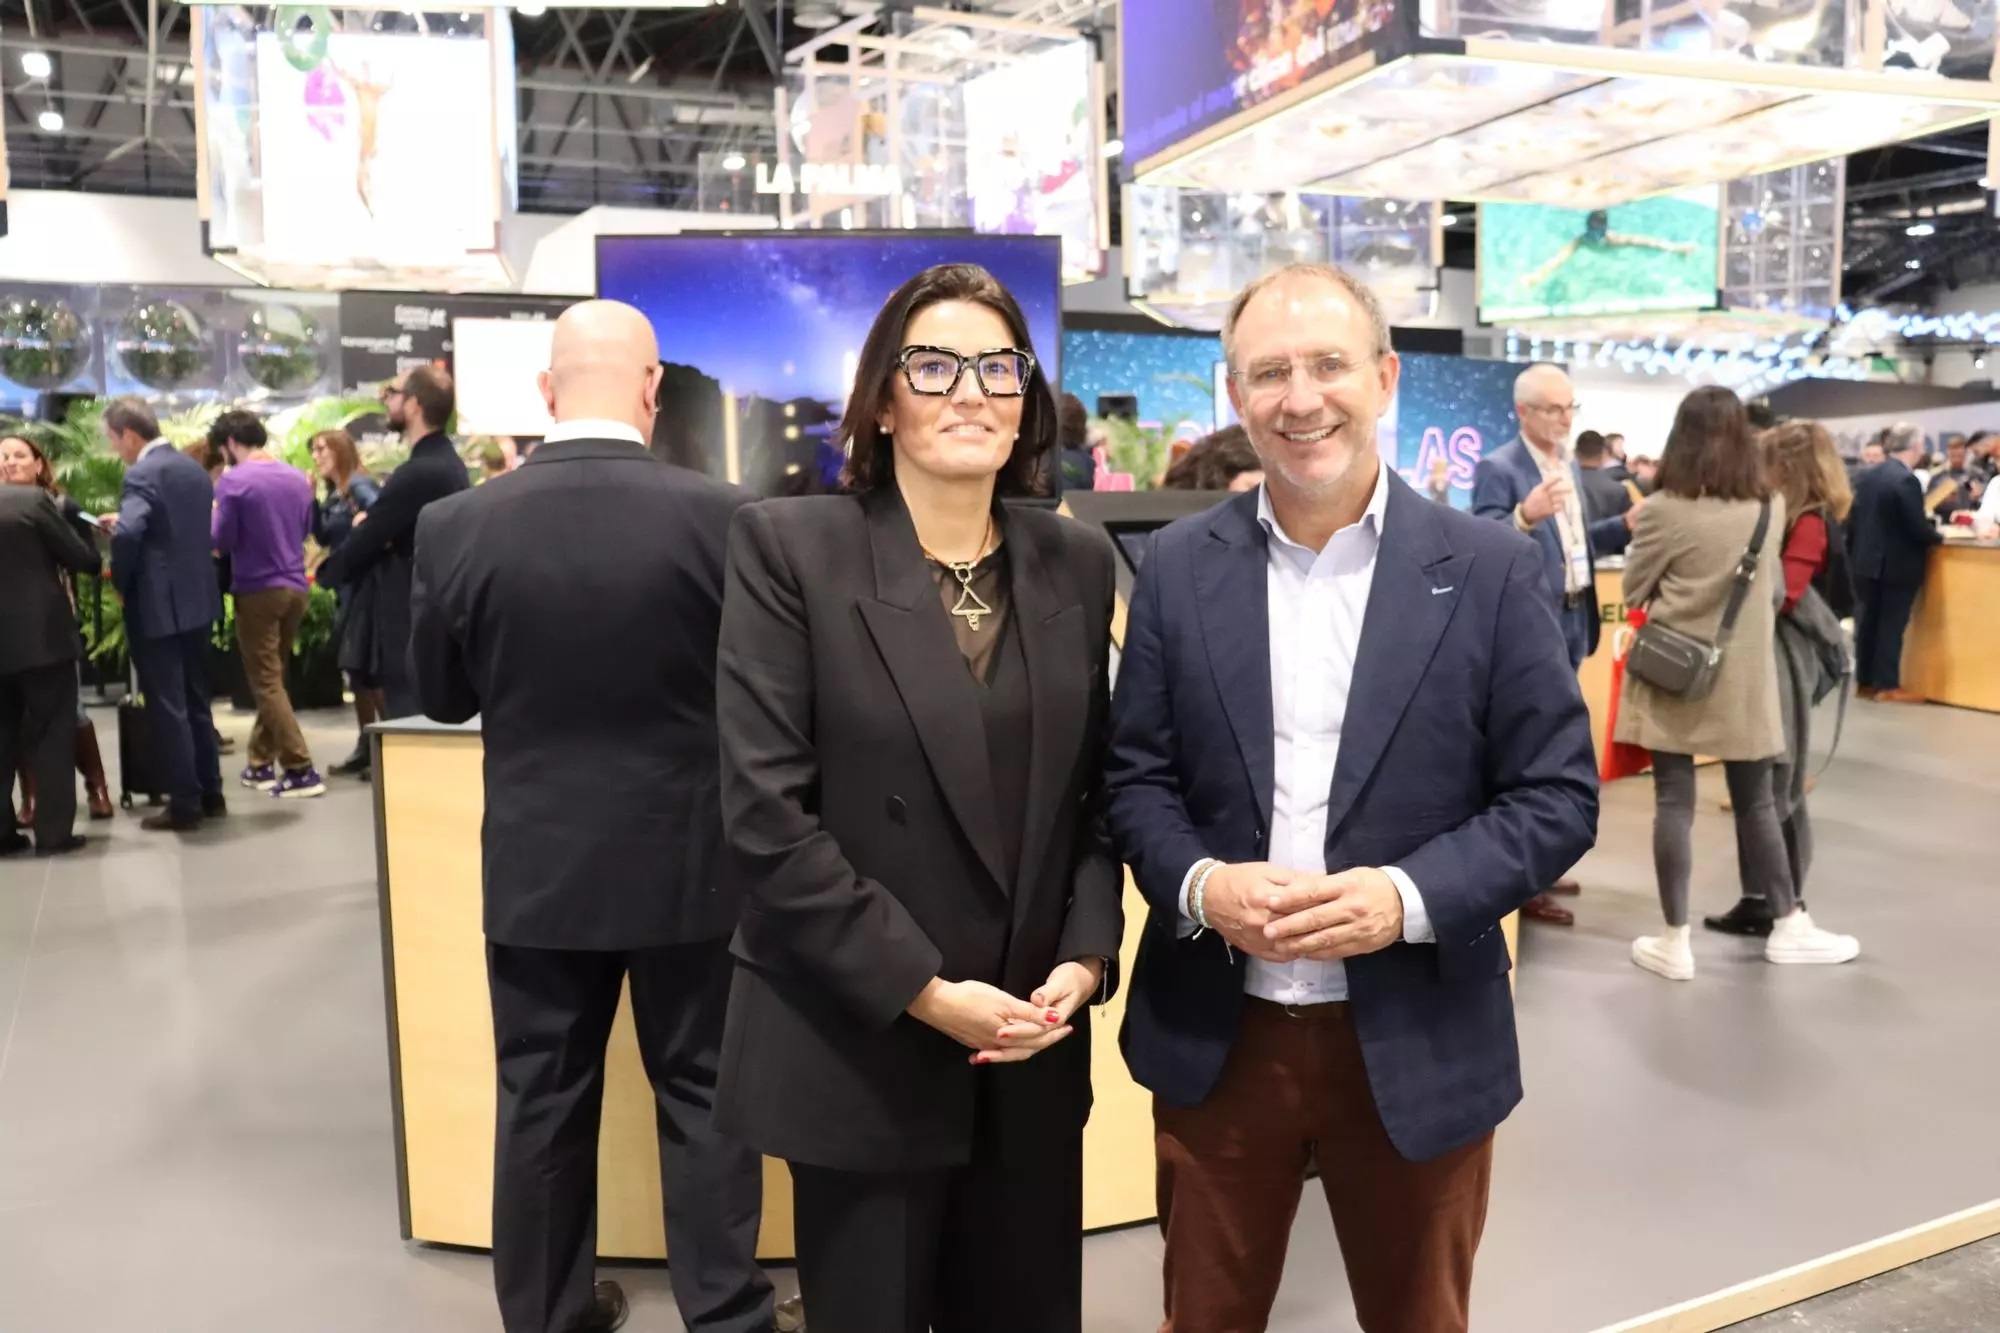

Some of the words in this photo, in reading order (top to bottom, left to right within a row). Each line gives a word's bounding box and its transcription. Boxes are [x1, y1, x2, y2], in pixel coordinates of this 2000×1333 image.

[756, 163, 794, 194] LA
[801, 163, 903, 195] PALMA
[1398, 426, 1482, 489] AS
